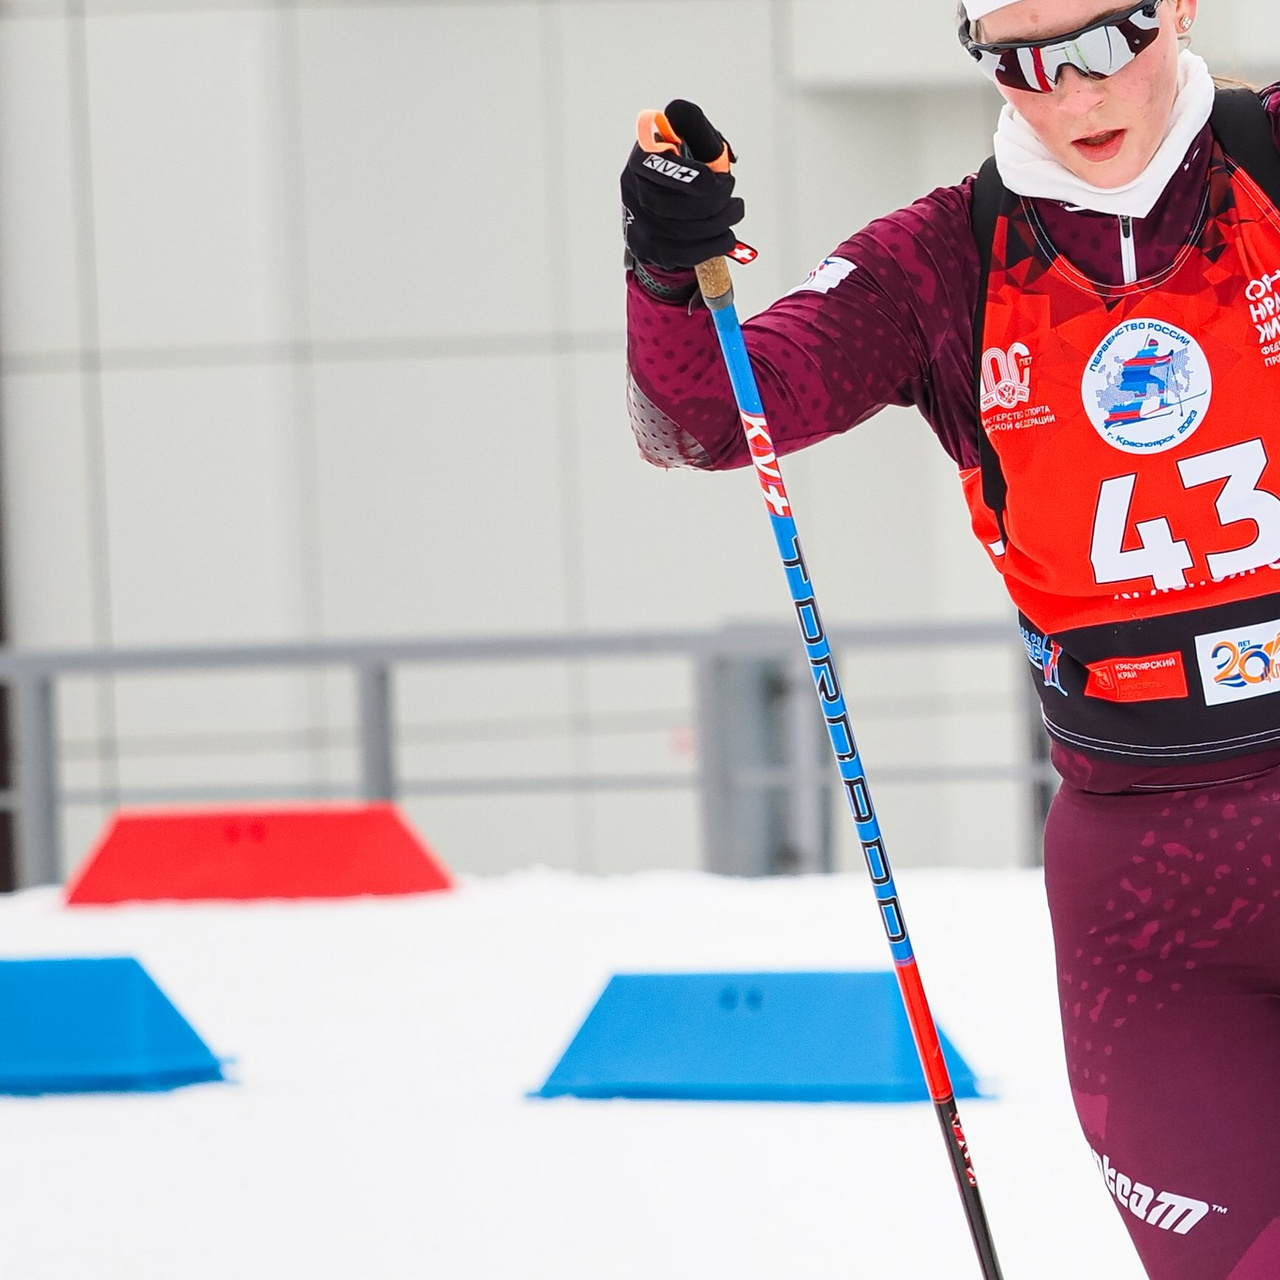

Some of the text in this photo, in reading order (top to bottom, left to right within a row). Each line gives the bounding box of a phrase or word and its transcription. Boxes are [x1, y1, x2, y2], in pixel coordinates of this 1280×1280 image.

[642, 154, 700, 184] KV+
[1089, 322, 1190, 372] ПЕРВЕНСТВО РОССИИ
[782, 533, 909, 946] TORNADO
